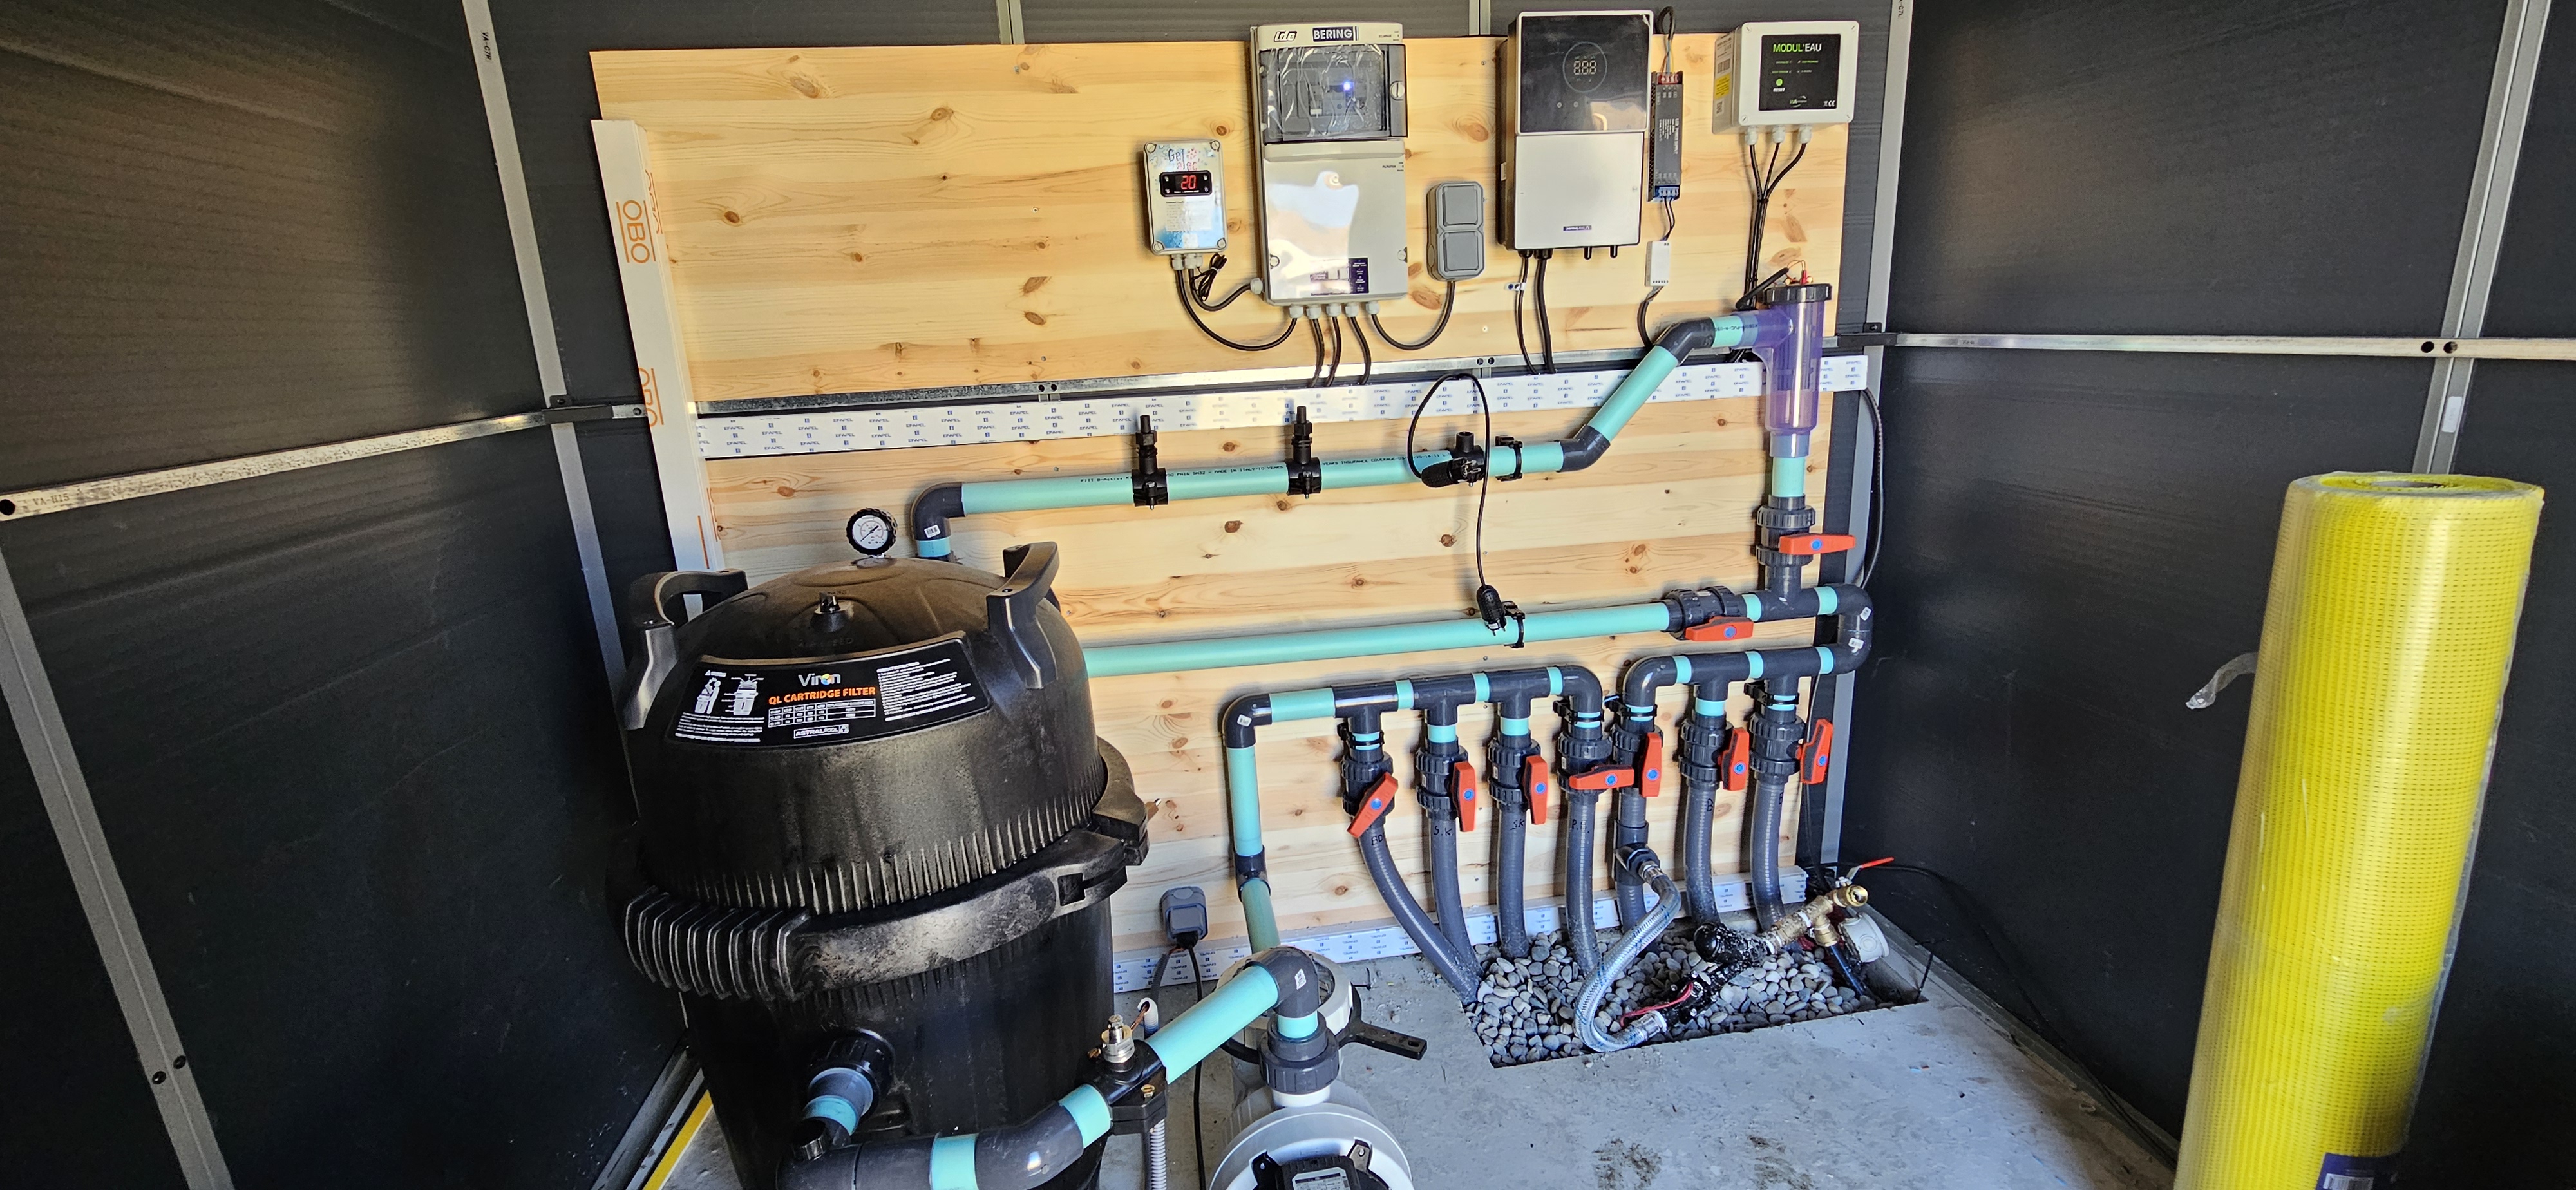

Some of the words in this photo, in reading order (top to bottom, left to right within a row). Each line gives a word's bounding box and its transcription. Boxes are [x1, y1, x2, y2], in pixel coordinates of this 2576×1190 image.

[1314, 29, 1353, 40] BERING
[482, 32, 492, 61] VA-C7R
[1773, 43, 1822, 53] MODUL'EAU
[1181, 175, 1196, 189] 20
[623, 200, 650, 263] OBO
[33, 493, 70, 505] VA-H15
[798, 673, 841, 687] Viron
[768, 696, 782, 705] QL
[784, 689, 841, 703] CARTRIDGE
[842, 686, 876, 697] FILTER
